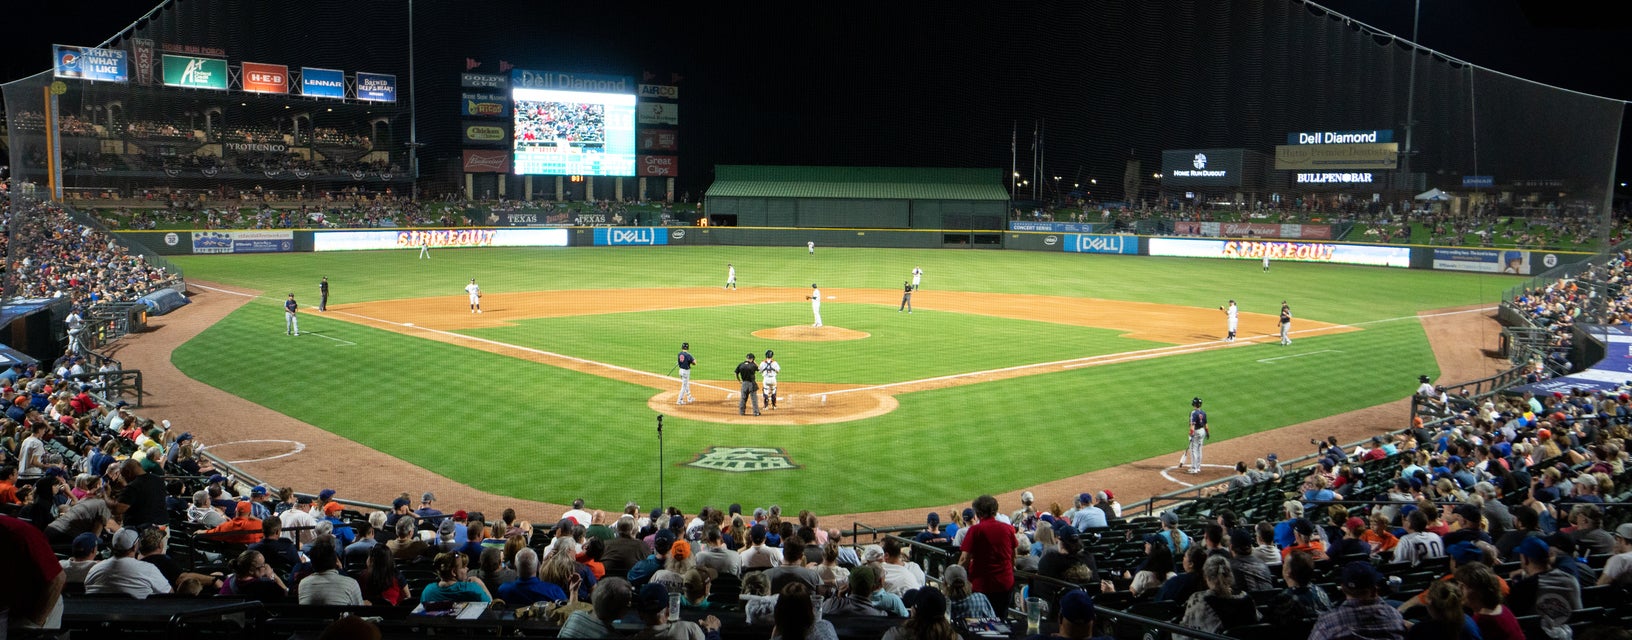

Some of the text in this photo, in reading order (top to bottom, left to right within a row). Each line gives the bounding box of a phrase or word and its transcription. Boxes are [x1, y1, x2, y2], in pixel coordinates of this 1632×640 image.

[88, 48, 123, 59] THAT'S
[88, 56, 119, 66] WHAT
[96, 66, 118, 74] LIKE
[304, 79, 342, 88] LENNAR
[522, 71, 626, 91] Dell Diamond
[1300, 131, 1377, 144] Dell Diamond
[645, 155, 672, 165] Great
[647, 164, 669, 176] Clips
[1297, 173, 1373, 183] BULLPEN BAR
[508, 215, 537, 223] TEXAS
[577, 215, 606, 223] TEXAS
[397, 229, 496, 247] STRIKEOUT
[613, 229, 650, 243] DELL
[1082, 237, 1119, 251] DELL
[1222, 241, 1336, 260] STRIKEOUT
